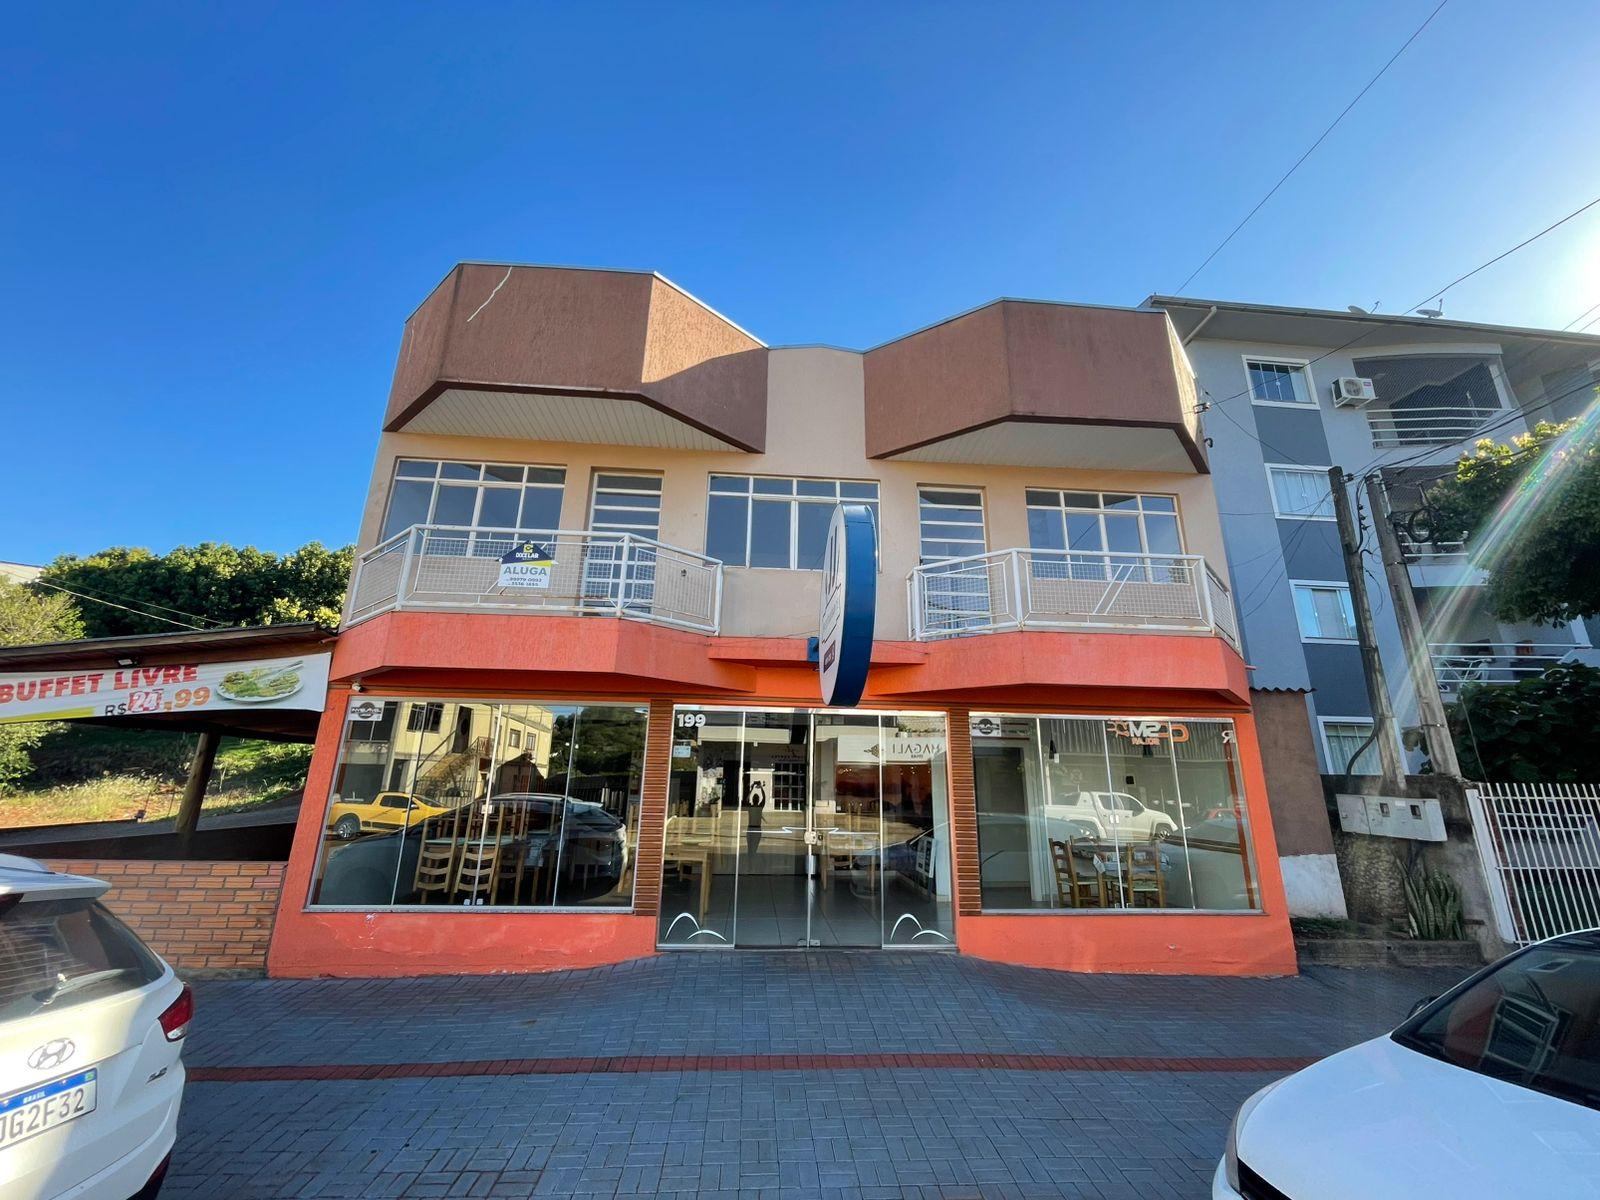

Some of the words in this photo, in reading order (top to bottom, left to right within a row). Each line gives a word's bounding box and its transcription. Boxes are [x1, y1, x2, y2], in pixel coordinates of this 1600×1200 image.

[503, 566, 547, 576] ALUGA
[0, 673, 105, 704] BUFFET
[113, 664, 198, 690] LIVRE
[676, 713, 706, 728] 199
